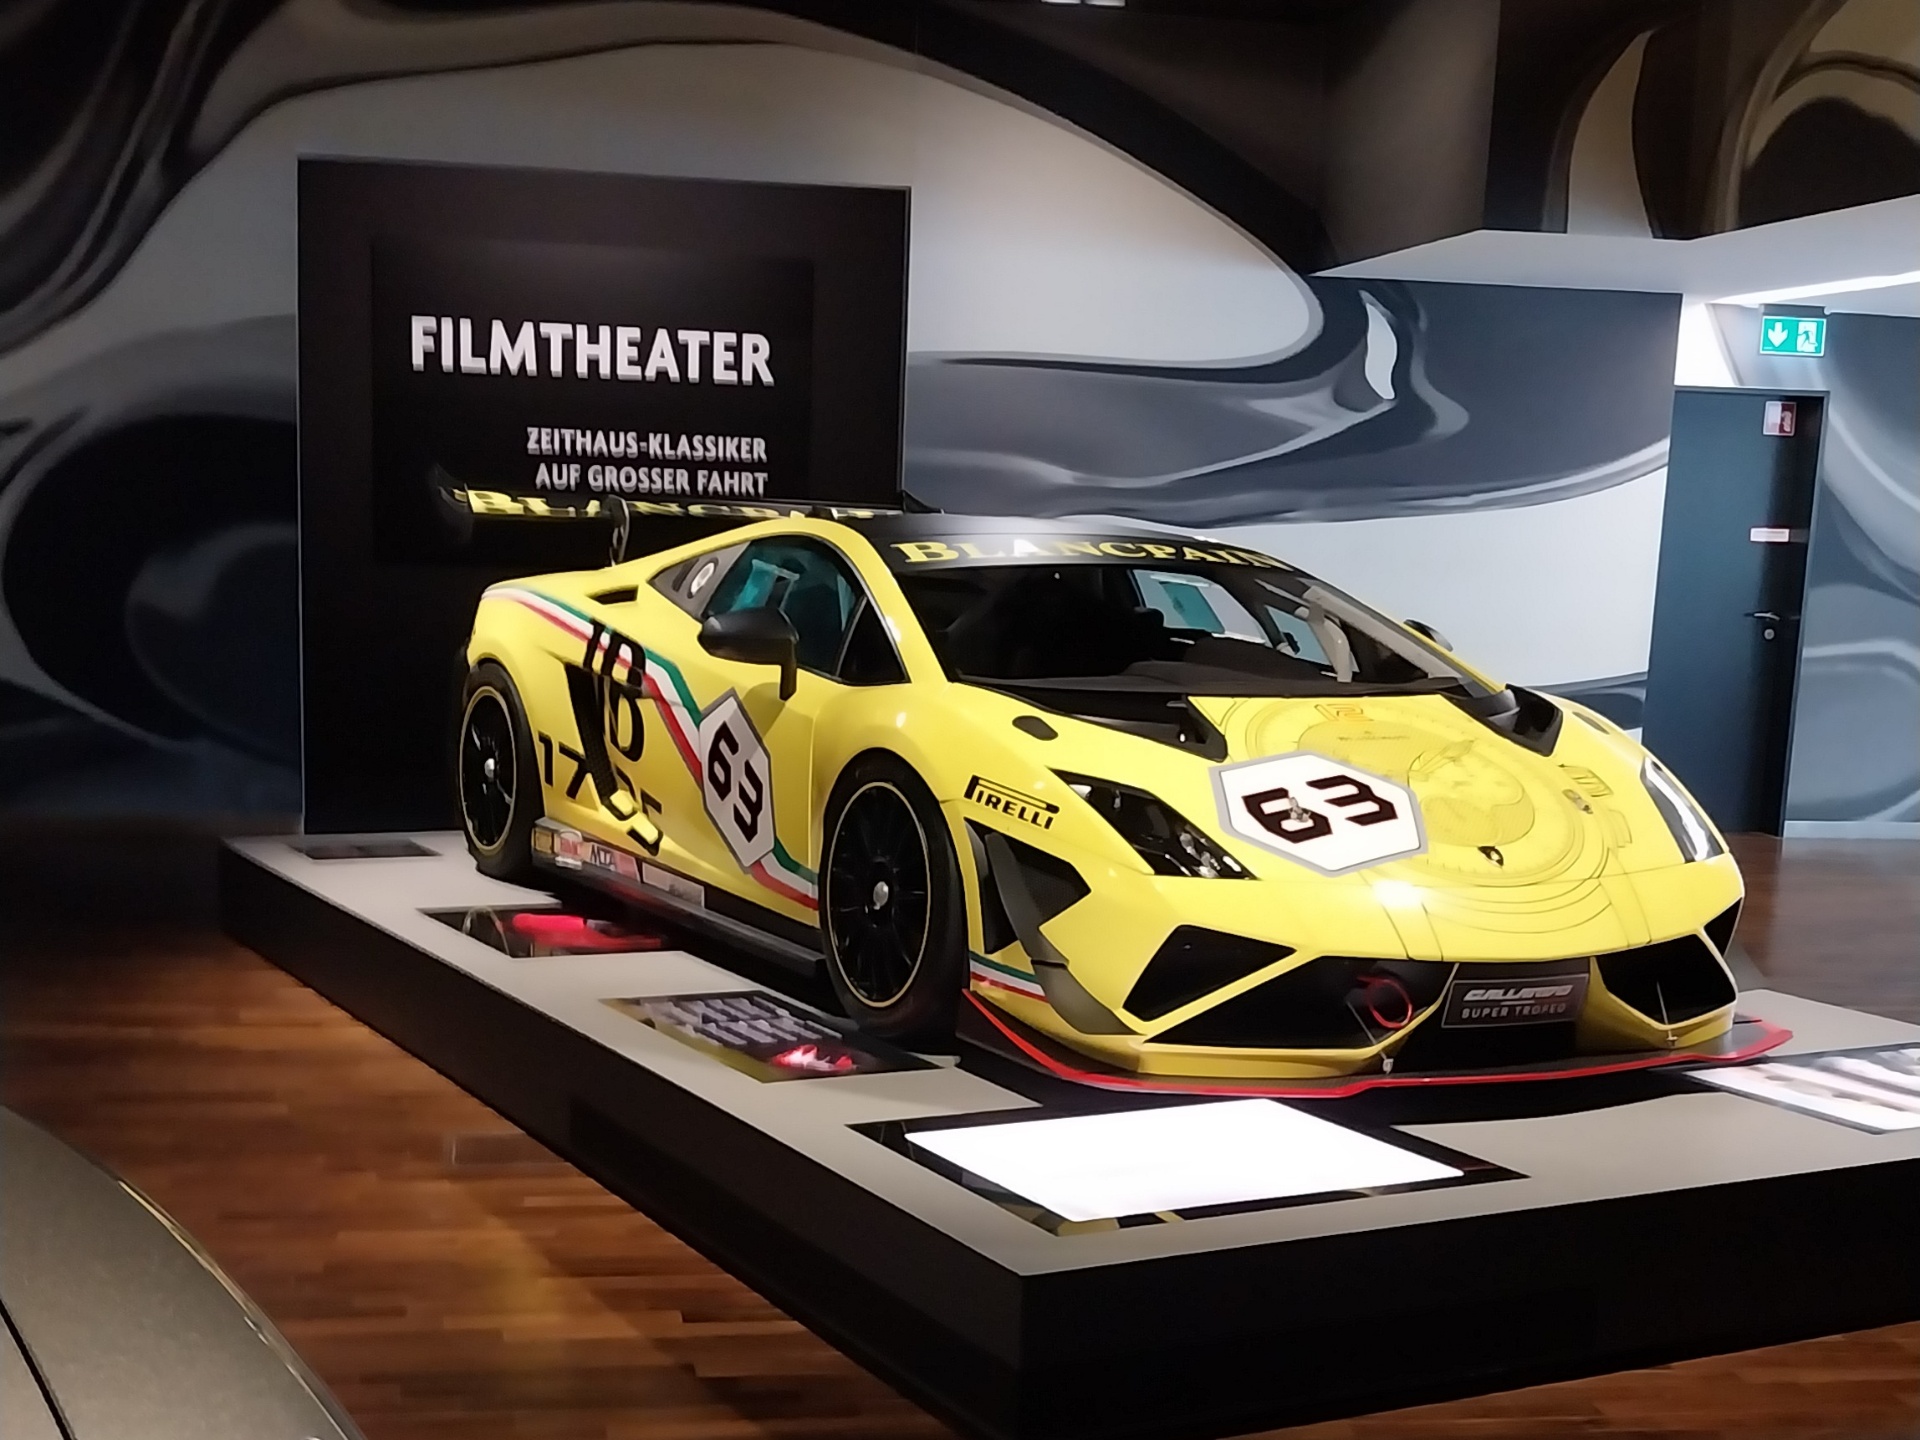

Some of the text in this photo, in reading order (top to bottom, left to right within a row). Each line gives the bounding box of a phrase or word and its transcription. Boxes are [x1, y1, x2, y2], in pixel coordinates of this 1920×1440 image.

[411, 315, 775, 386] FILMTHEATER
[526, 427, 767, 463] ZEITHAUS-KLASSIKER
[535, 462, 768, 497] AUF GROSSER FAHRT
[890, 539, 1295, 573] BLANCPAIN
[707, 720, 764, 843] 63
[963, 774, 1060, 830] PIRELLI
[1241, 774, 1398, 844] 63
[1461, 1006, 1508, 1019] SUPER
